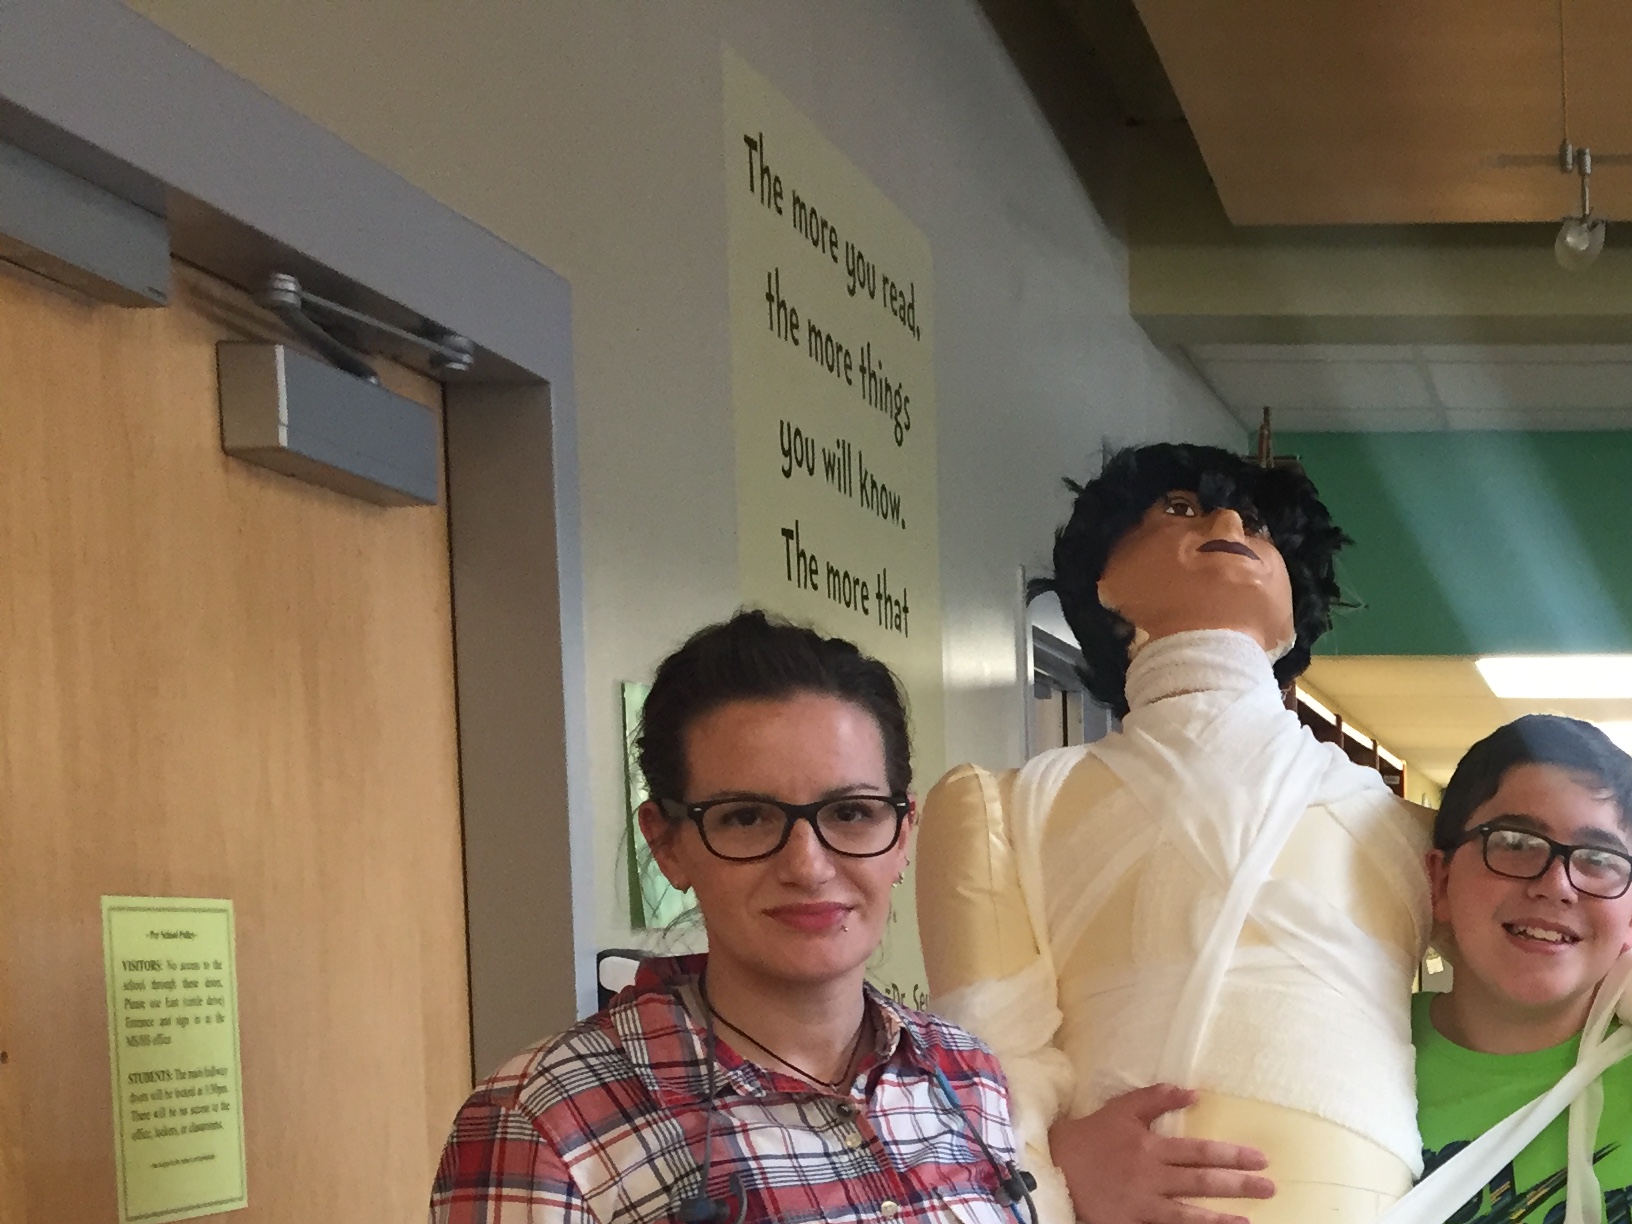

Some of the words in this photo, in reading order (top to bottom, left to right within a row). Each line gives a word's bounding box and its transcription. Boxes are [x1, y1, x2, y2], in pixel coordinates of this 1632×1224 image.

[743, 131, 783, 216] The
[792, 189, 838, 264] more
[845, 240, 876, 299] you
[765, 267, 800, 346] the
[807, 318, 853, 386] more
[859, 340, 911, 448] things
[779, 419, 816, 479] you
[822, 438, 852, 498] will
[858, 450, 906, 530] know.
[780, 519, 819, 592] The
[826, 561, 869, 616] more
[875, 567, 909, 639] that
